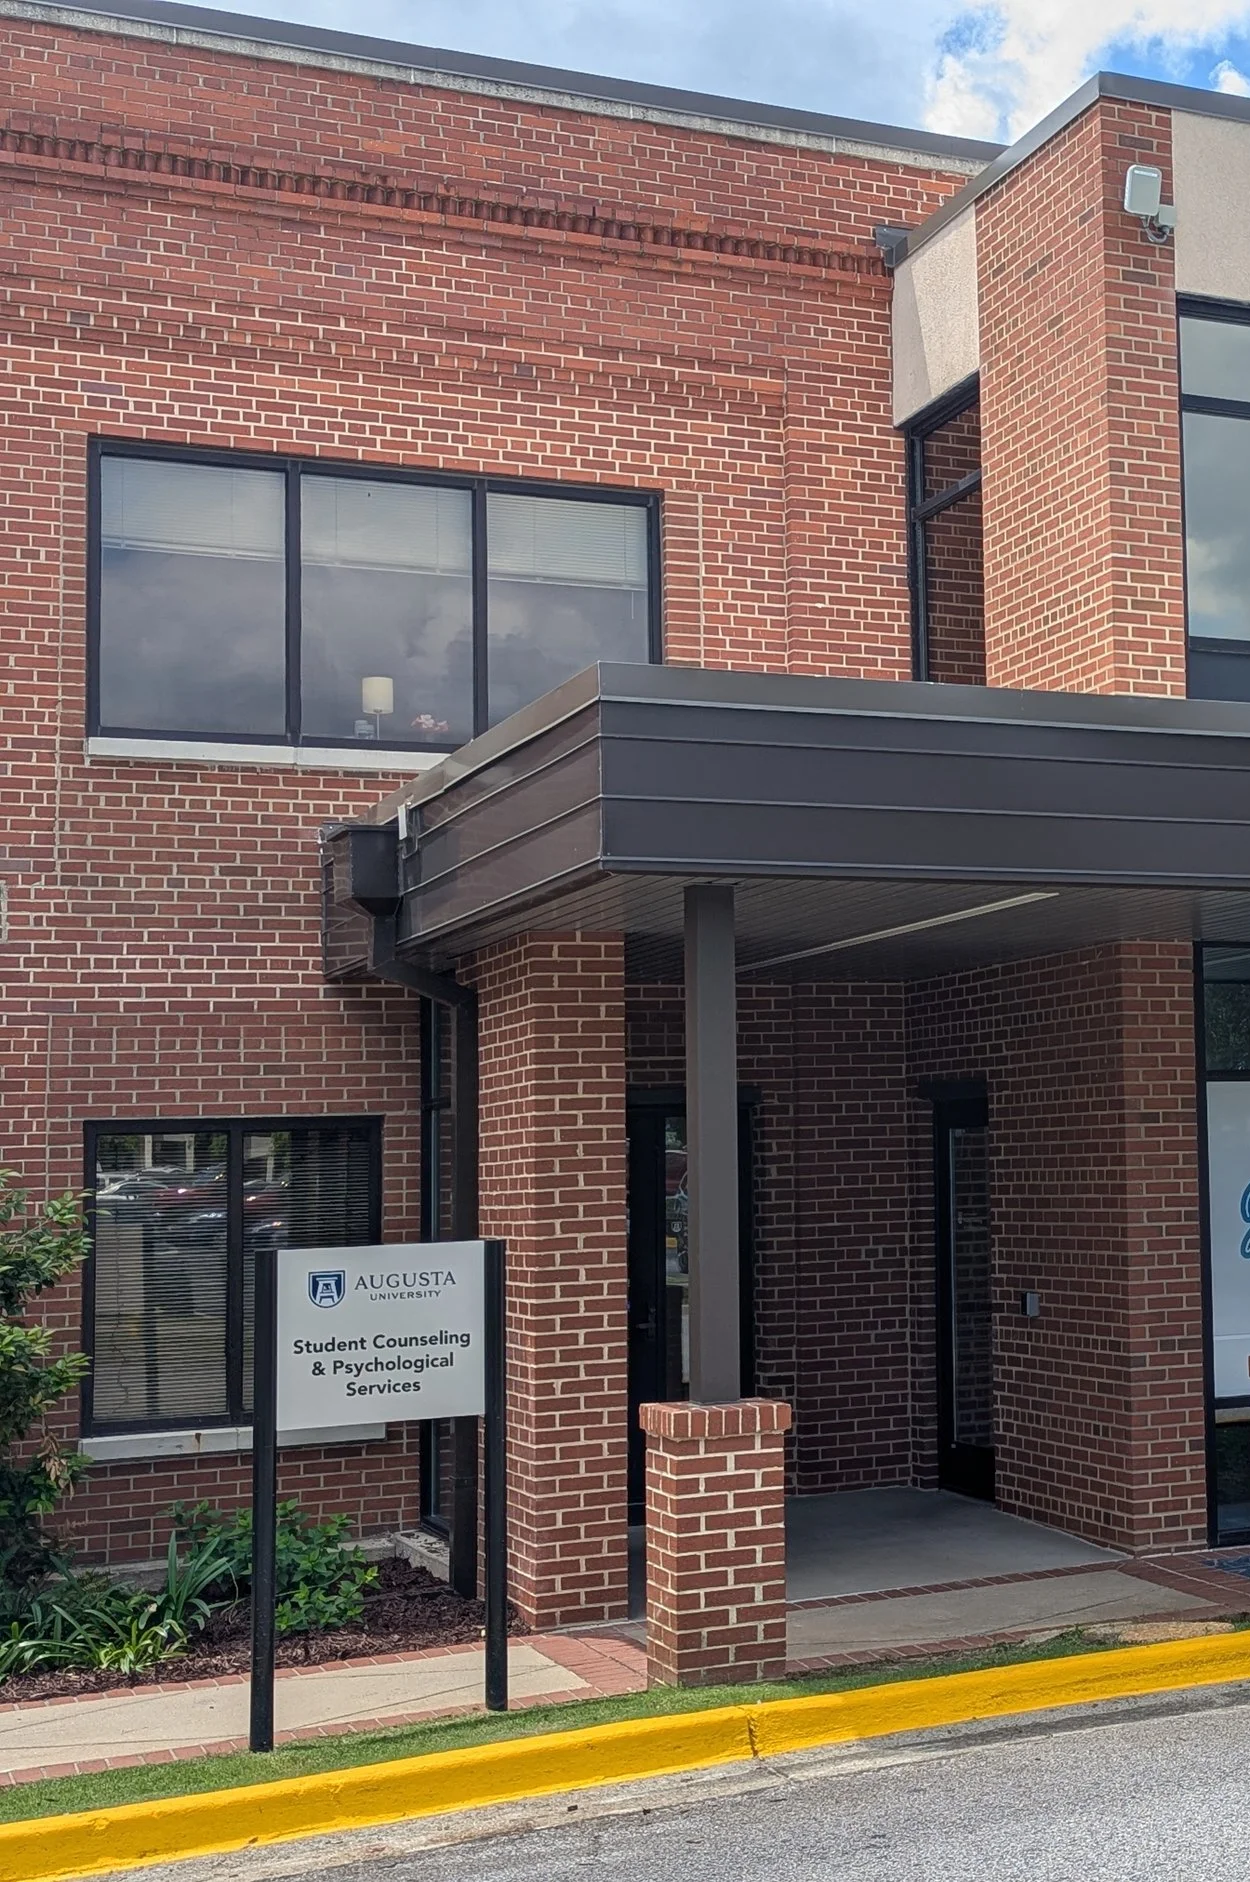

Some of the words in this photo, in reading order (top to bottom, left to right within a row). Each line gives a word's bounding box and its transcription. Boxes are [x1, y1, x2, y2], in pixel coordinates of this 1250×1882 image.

[354, 1271, 457, 1291] AUGUSTA
[369, 1290, 442, 1301] UNIVERSITY
[293, 1336, 367, 1355] Student
[372, 1330, 471, 1348] Counseling
[311, 1361, 326, 1376] &
[333, 1352, 454, 1377] Psychological
[346, 1379, 421, 1397] Services
